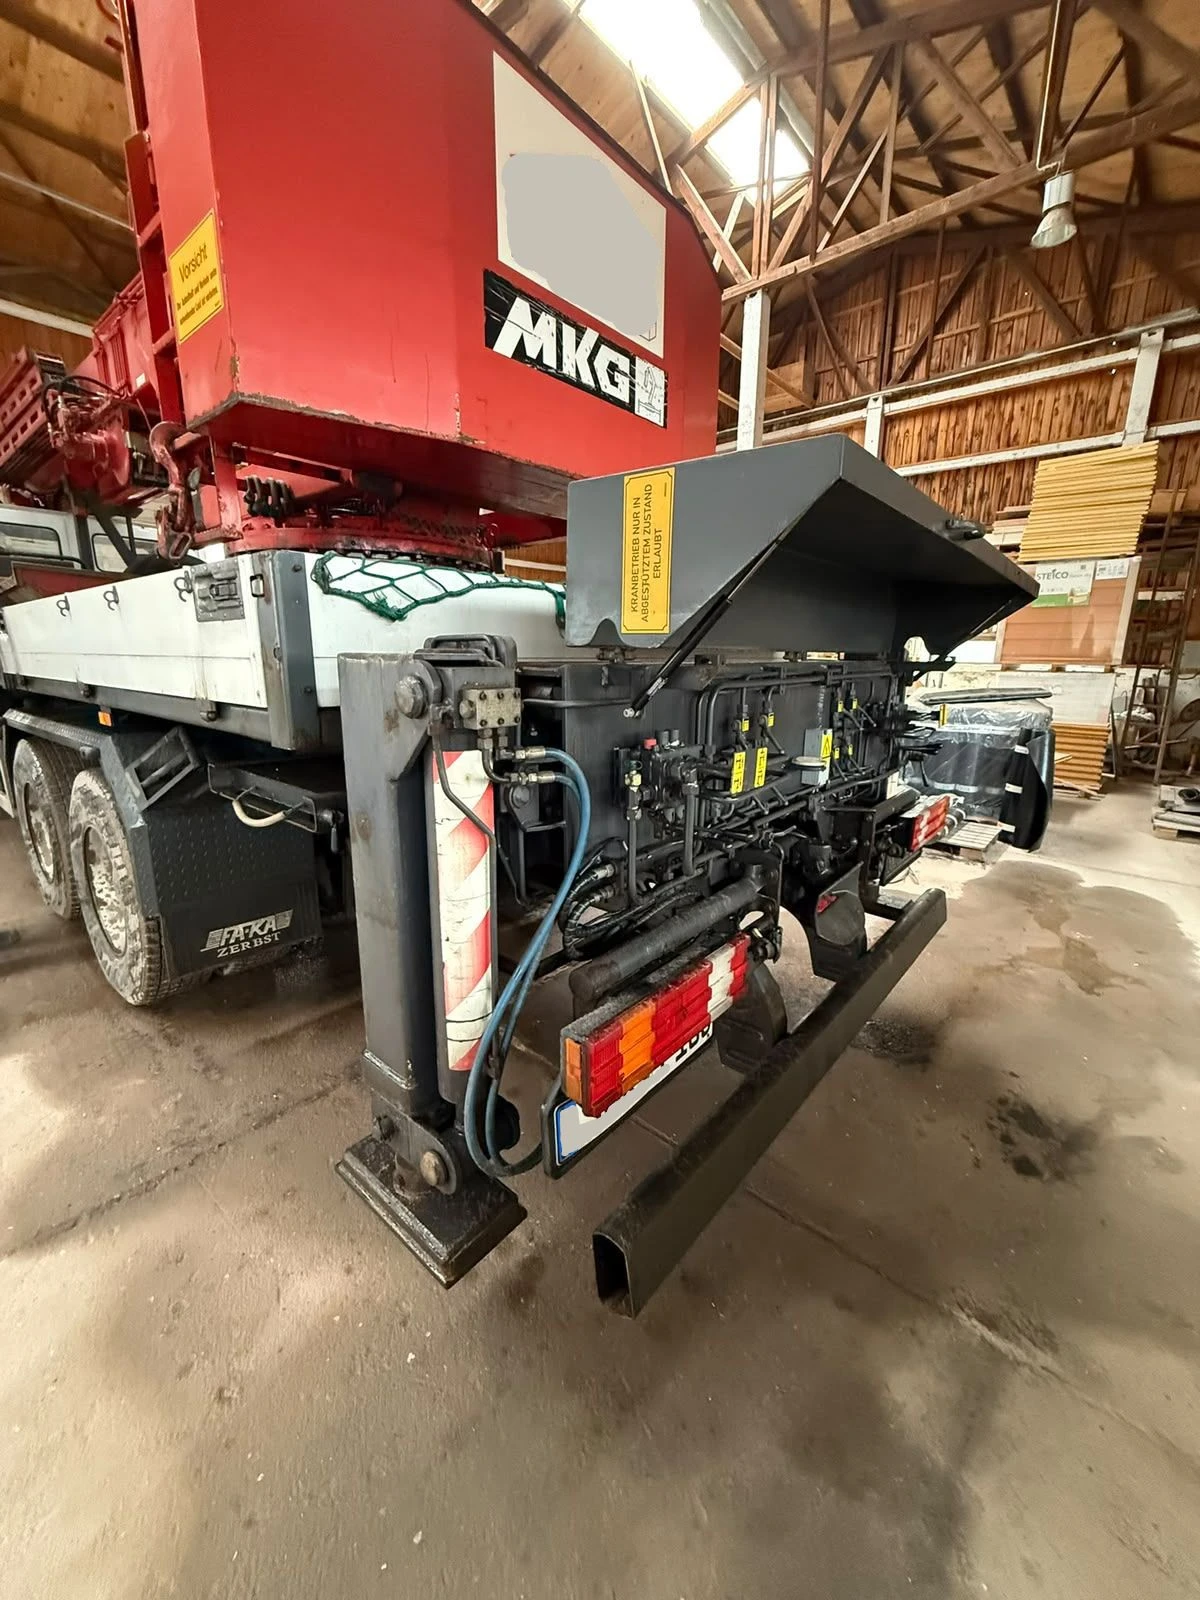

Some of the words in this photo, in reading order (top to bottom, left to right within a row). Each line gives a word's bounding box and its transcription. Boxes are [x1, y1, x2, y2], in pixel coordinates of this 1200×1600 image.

[179, 244, 208, 283] Vorsicht
[492, 296, 631, 404] MKG
[632, 512, 641, 535] NUR
[633, 497, 641, 509] IN
[643, 483, 653, 535] ZUSTAND
[630, 538, 641, 613] KRANBETRIEB
[653, 528, 663, 579] ERLAUBT
[641, 538, 652, 623] ABGESTÜTZTEM
[217, 931, 281, 958] ZERBST
